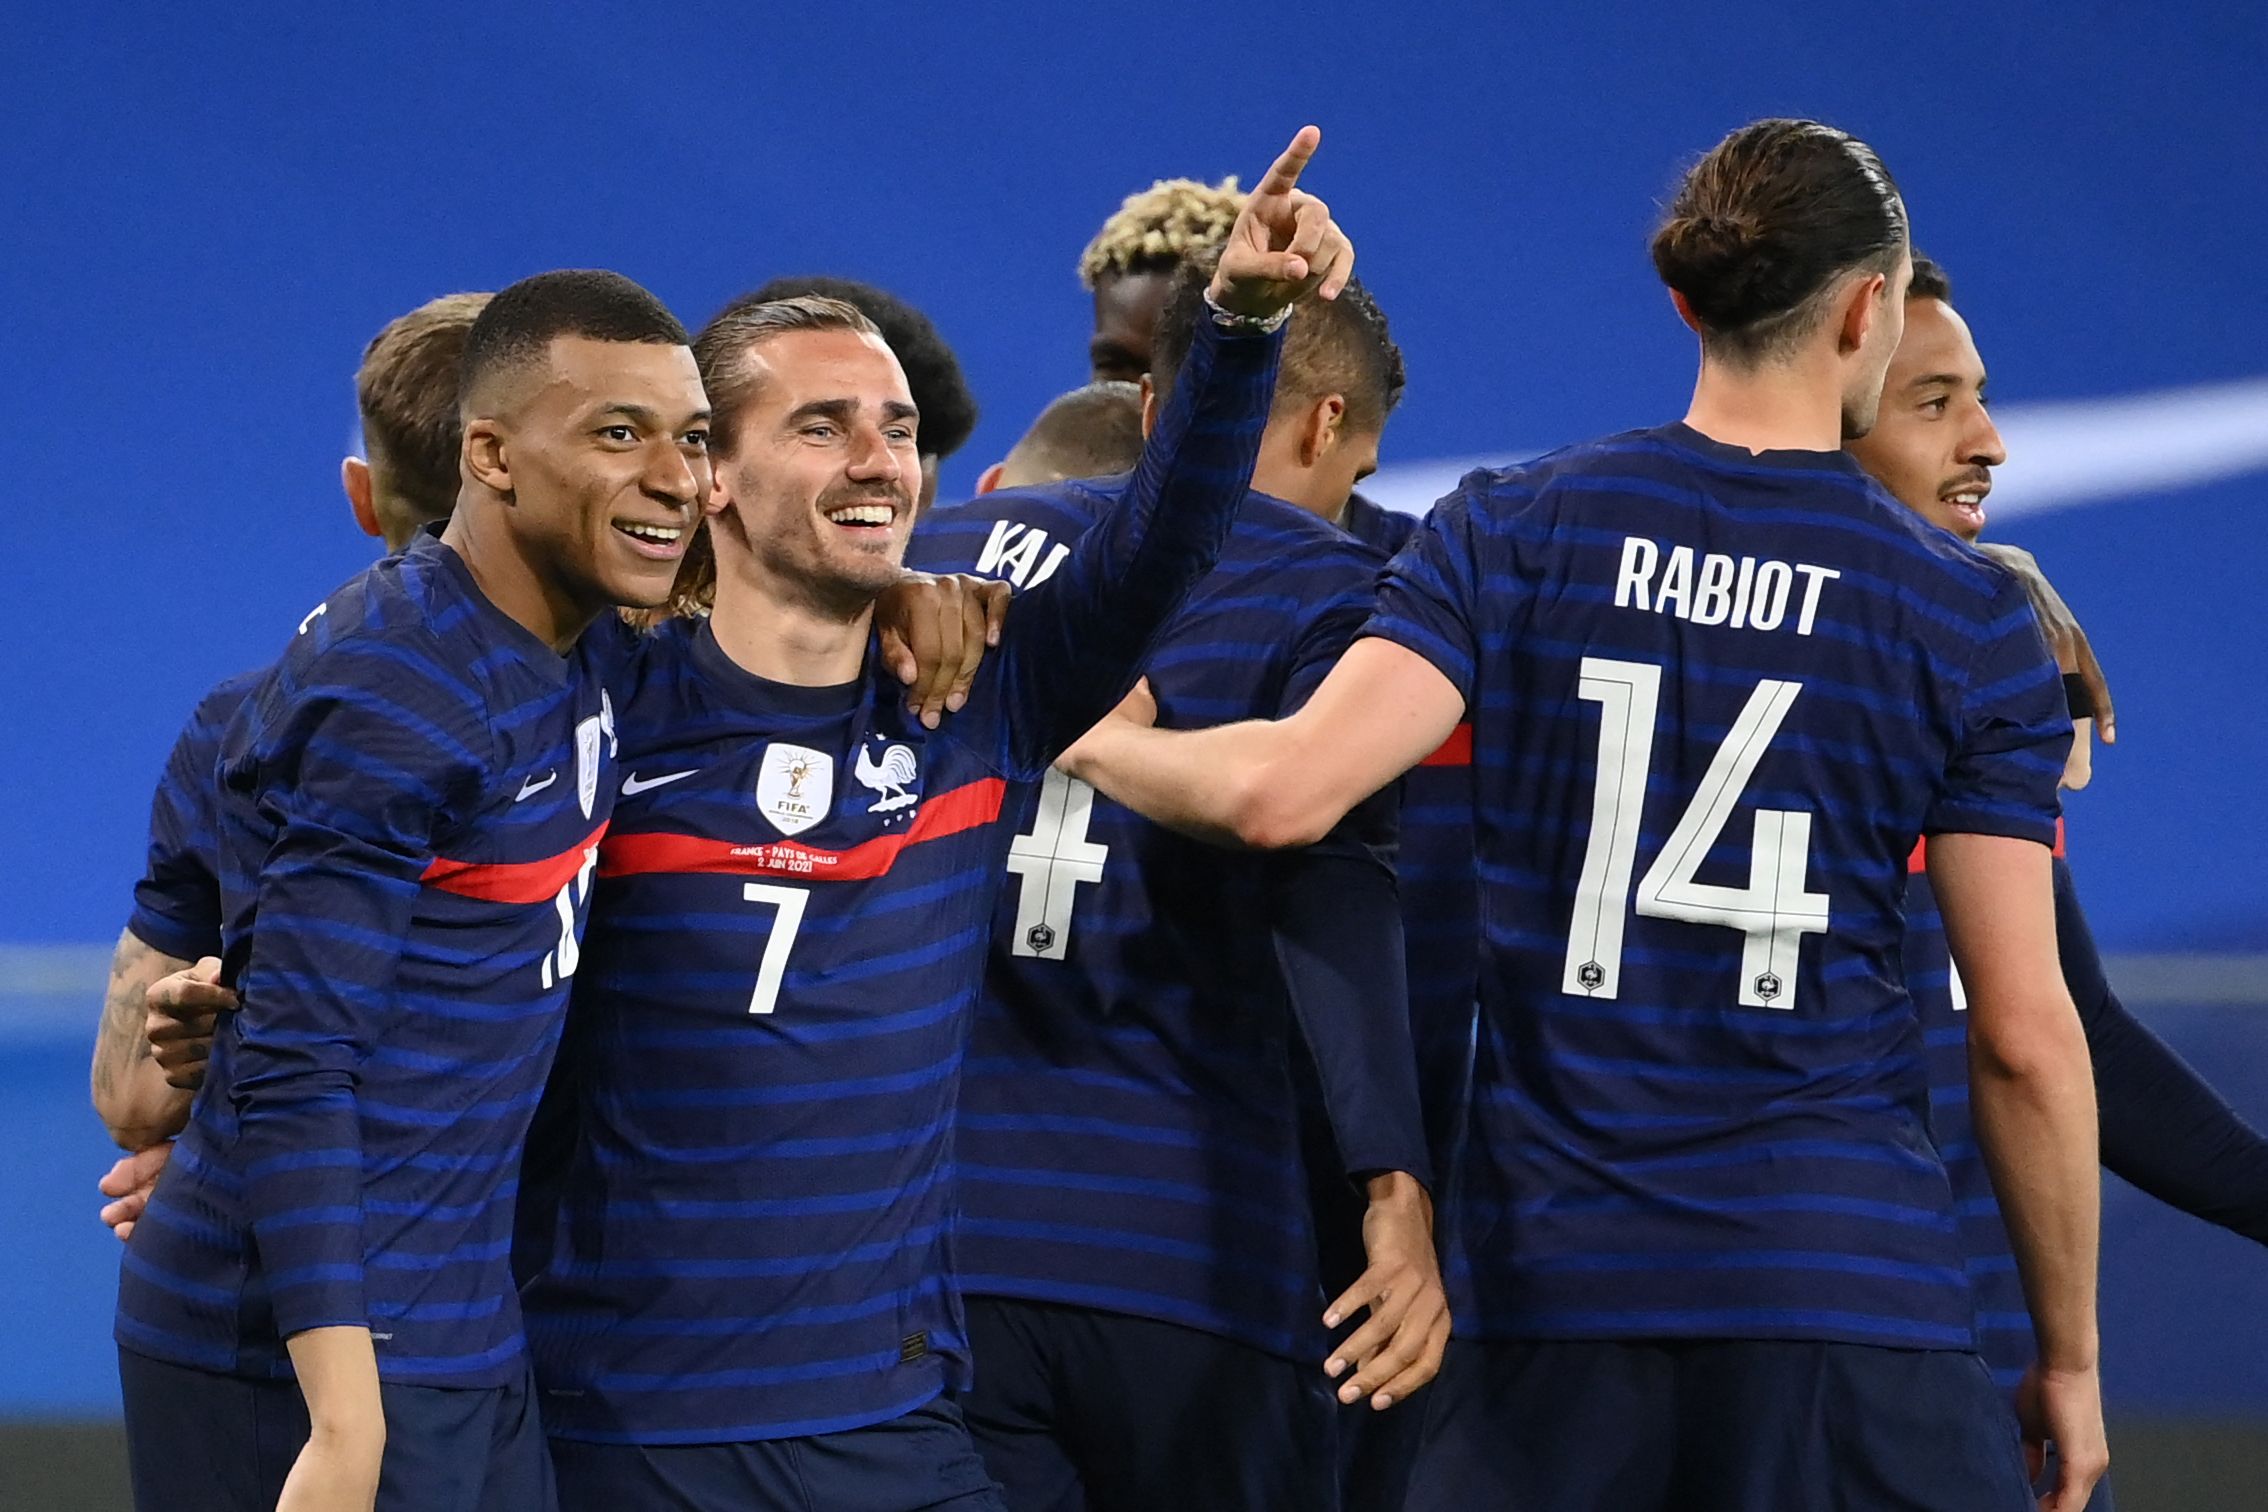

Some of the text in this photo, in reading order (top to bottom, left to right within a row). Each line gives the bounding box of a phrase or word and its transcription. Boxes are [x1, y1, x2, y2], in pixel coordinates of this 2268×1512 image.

[1614, 536, 1841, 636] RABIOT
[777, 800, 807, 814] FIFA
[1561, 656, 1830, 1011] 14
[730, 847, 763, 856] FRANCE
[772, 846, 794, 858] PAYS
[808, 854, 838, 865] GALLES
[757, 857, 764, 867] 2
[787, 860, 813, 872] 2021
[743, 882, 811, 1014] 7
